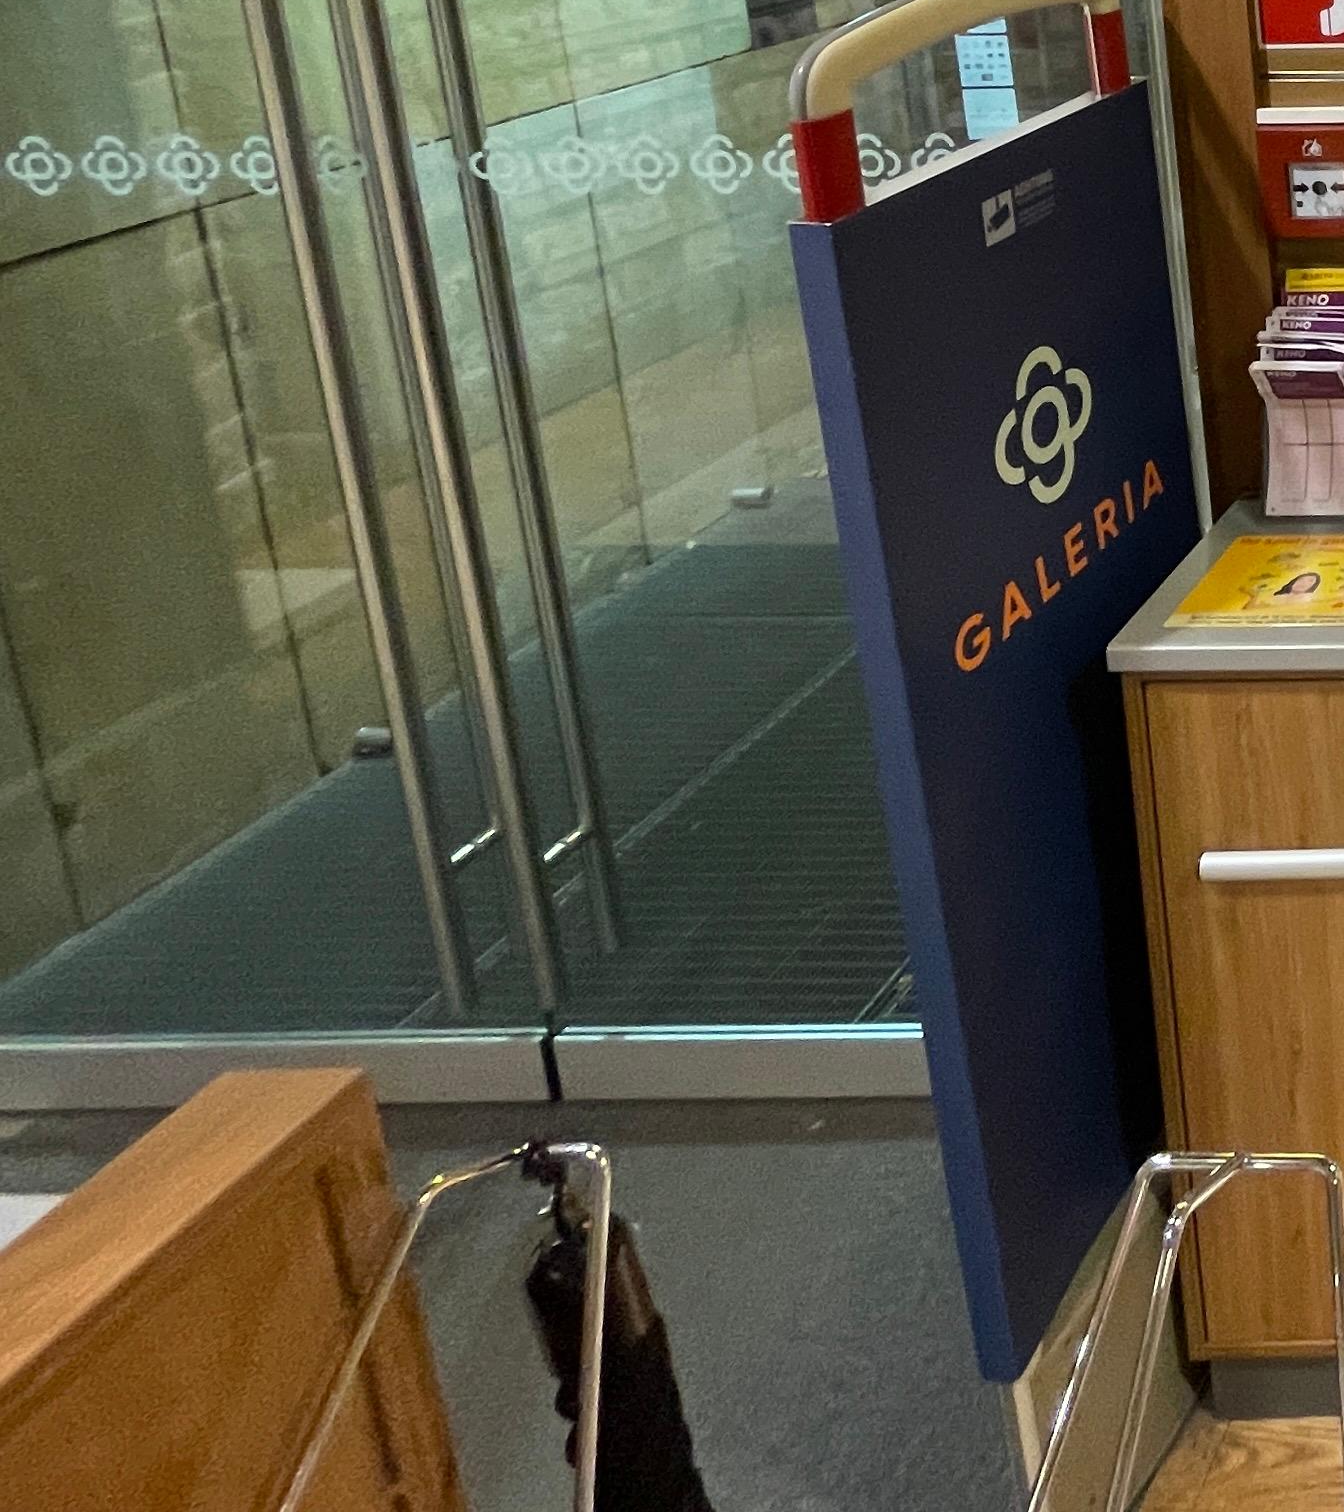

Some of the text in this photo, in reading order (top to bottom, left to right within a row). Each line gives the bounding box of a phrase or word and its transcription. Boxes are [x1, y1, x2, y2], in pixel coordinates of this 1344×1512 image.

[1287, 293, 1330, 306] KENO
[1282, 321, 1312, 330] KENO
[953, 460, 1165, 674] GALERIA
